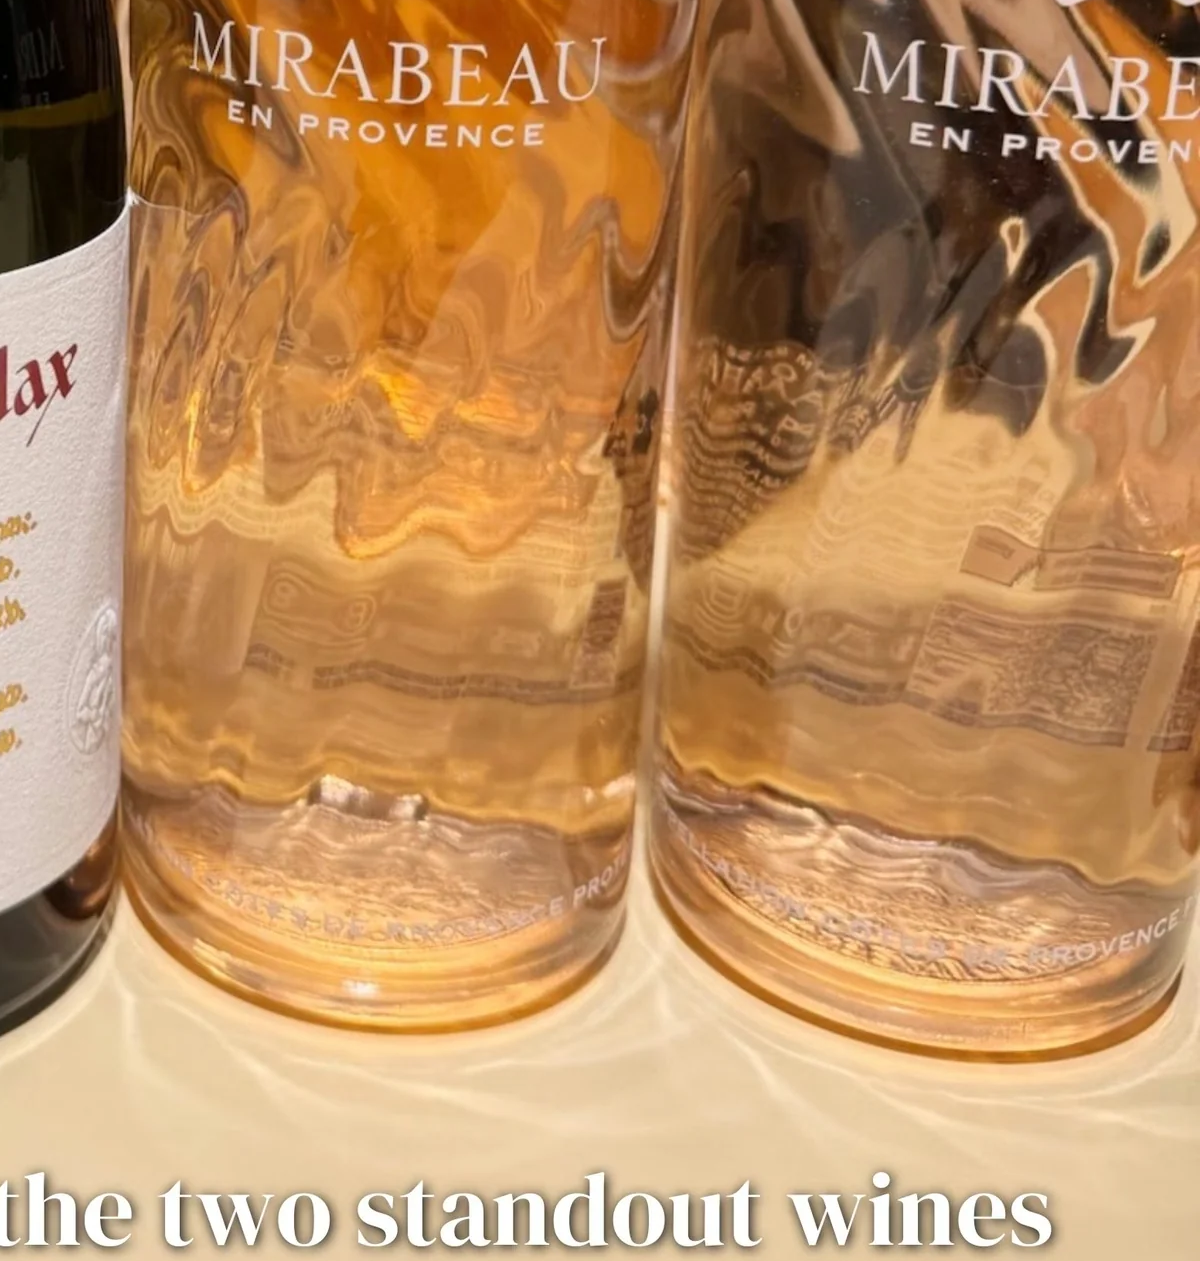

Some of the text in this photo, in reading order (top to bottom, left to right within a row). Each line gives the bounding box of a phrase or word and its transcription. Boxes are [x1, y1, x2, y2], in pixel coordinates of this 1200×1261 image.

[189, 12, 608, 109] MIRABEAU
[853, 31, 1200, 122] MIRABE
[227, 100, 545, 148] EN PROVENCE
[909, 121, 1200, 166] EN PROVEN
